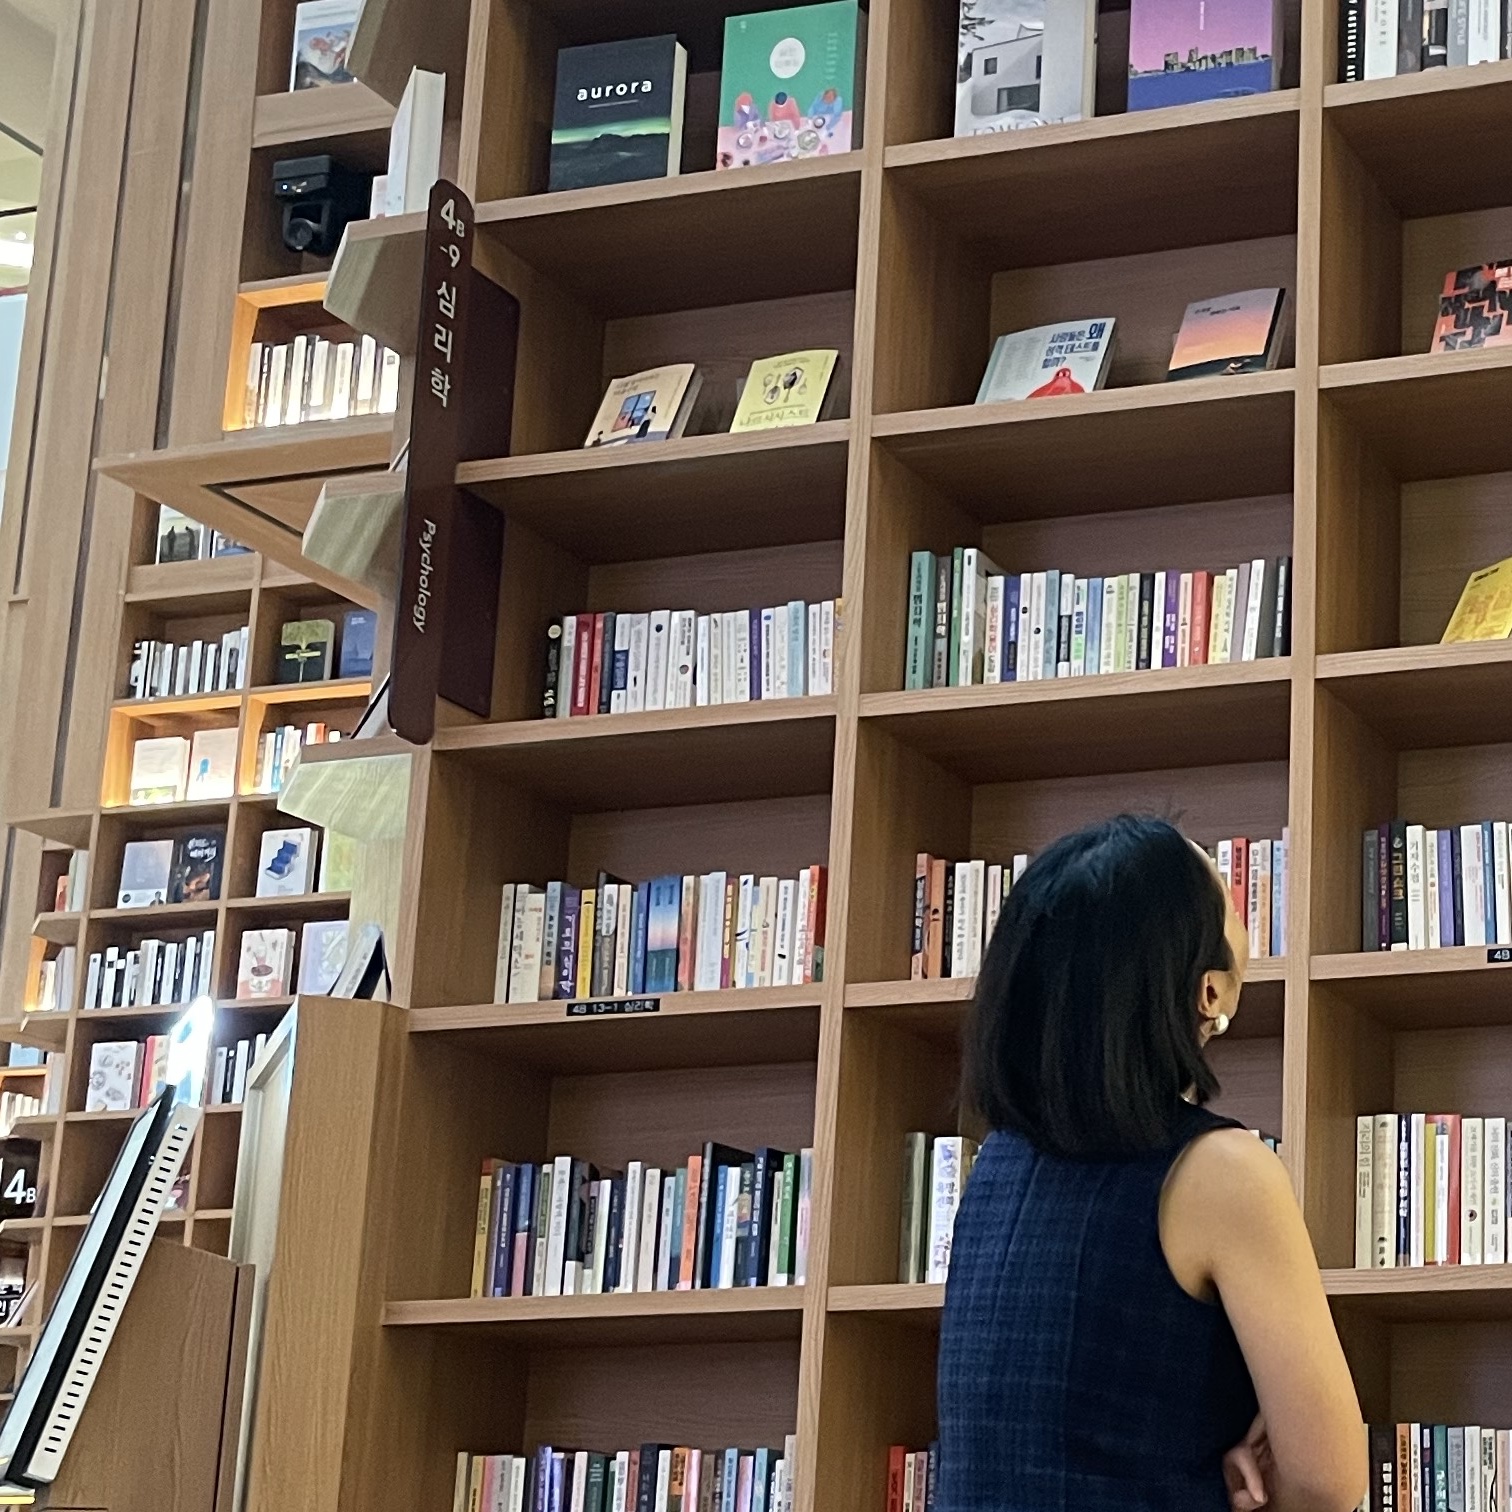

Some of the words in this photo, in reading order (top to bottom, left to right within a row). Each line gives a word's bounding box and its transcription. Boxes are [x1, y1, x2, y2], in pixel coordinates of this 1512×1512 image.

[576, 77, 653, 102] aurora
[440, 198, 466, 238] 4B
[430, 280, 457, 408] 심리학
[1086, 321, 1107, 340] 왜
[412, 518, 437, 634] Psychology
[1494, 949, 1511, 961] 4B
[592, 1002, 619, 1013] 13-1
[3, 1168, 38, 1206] 4B
